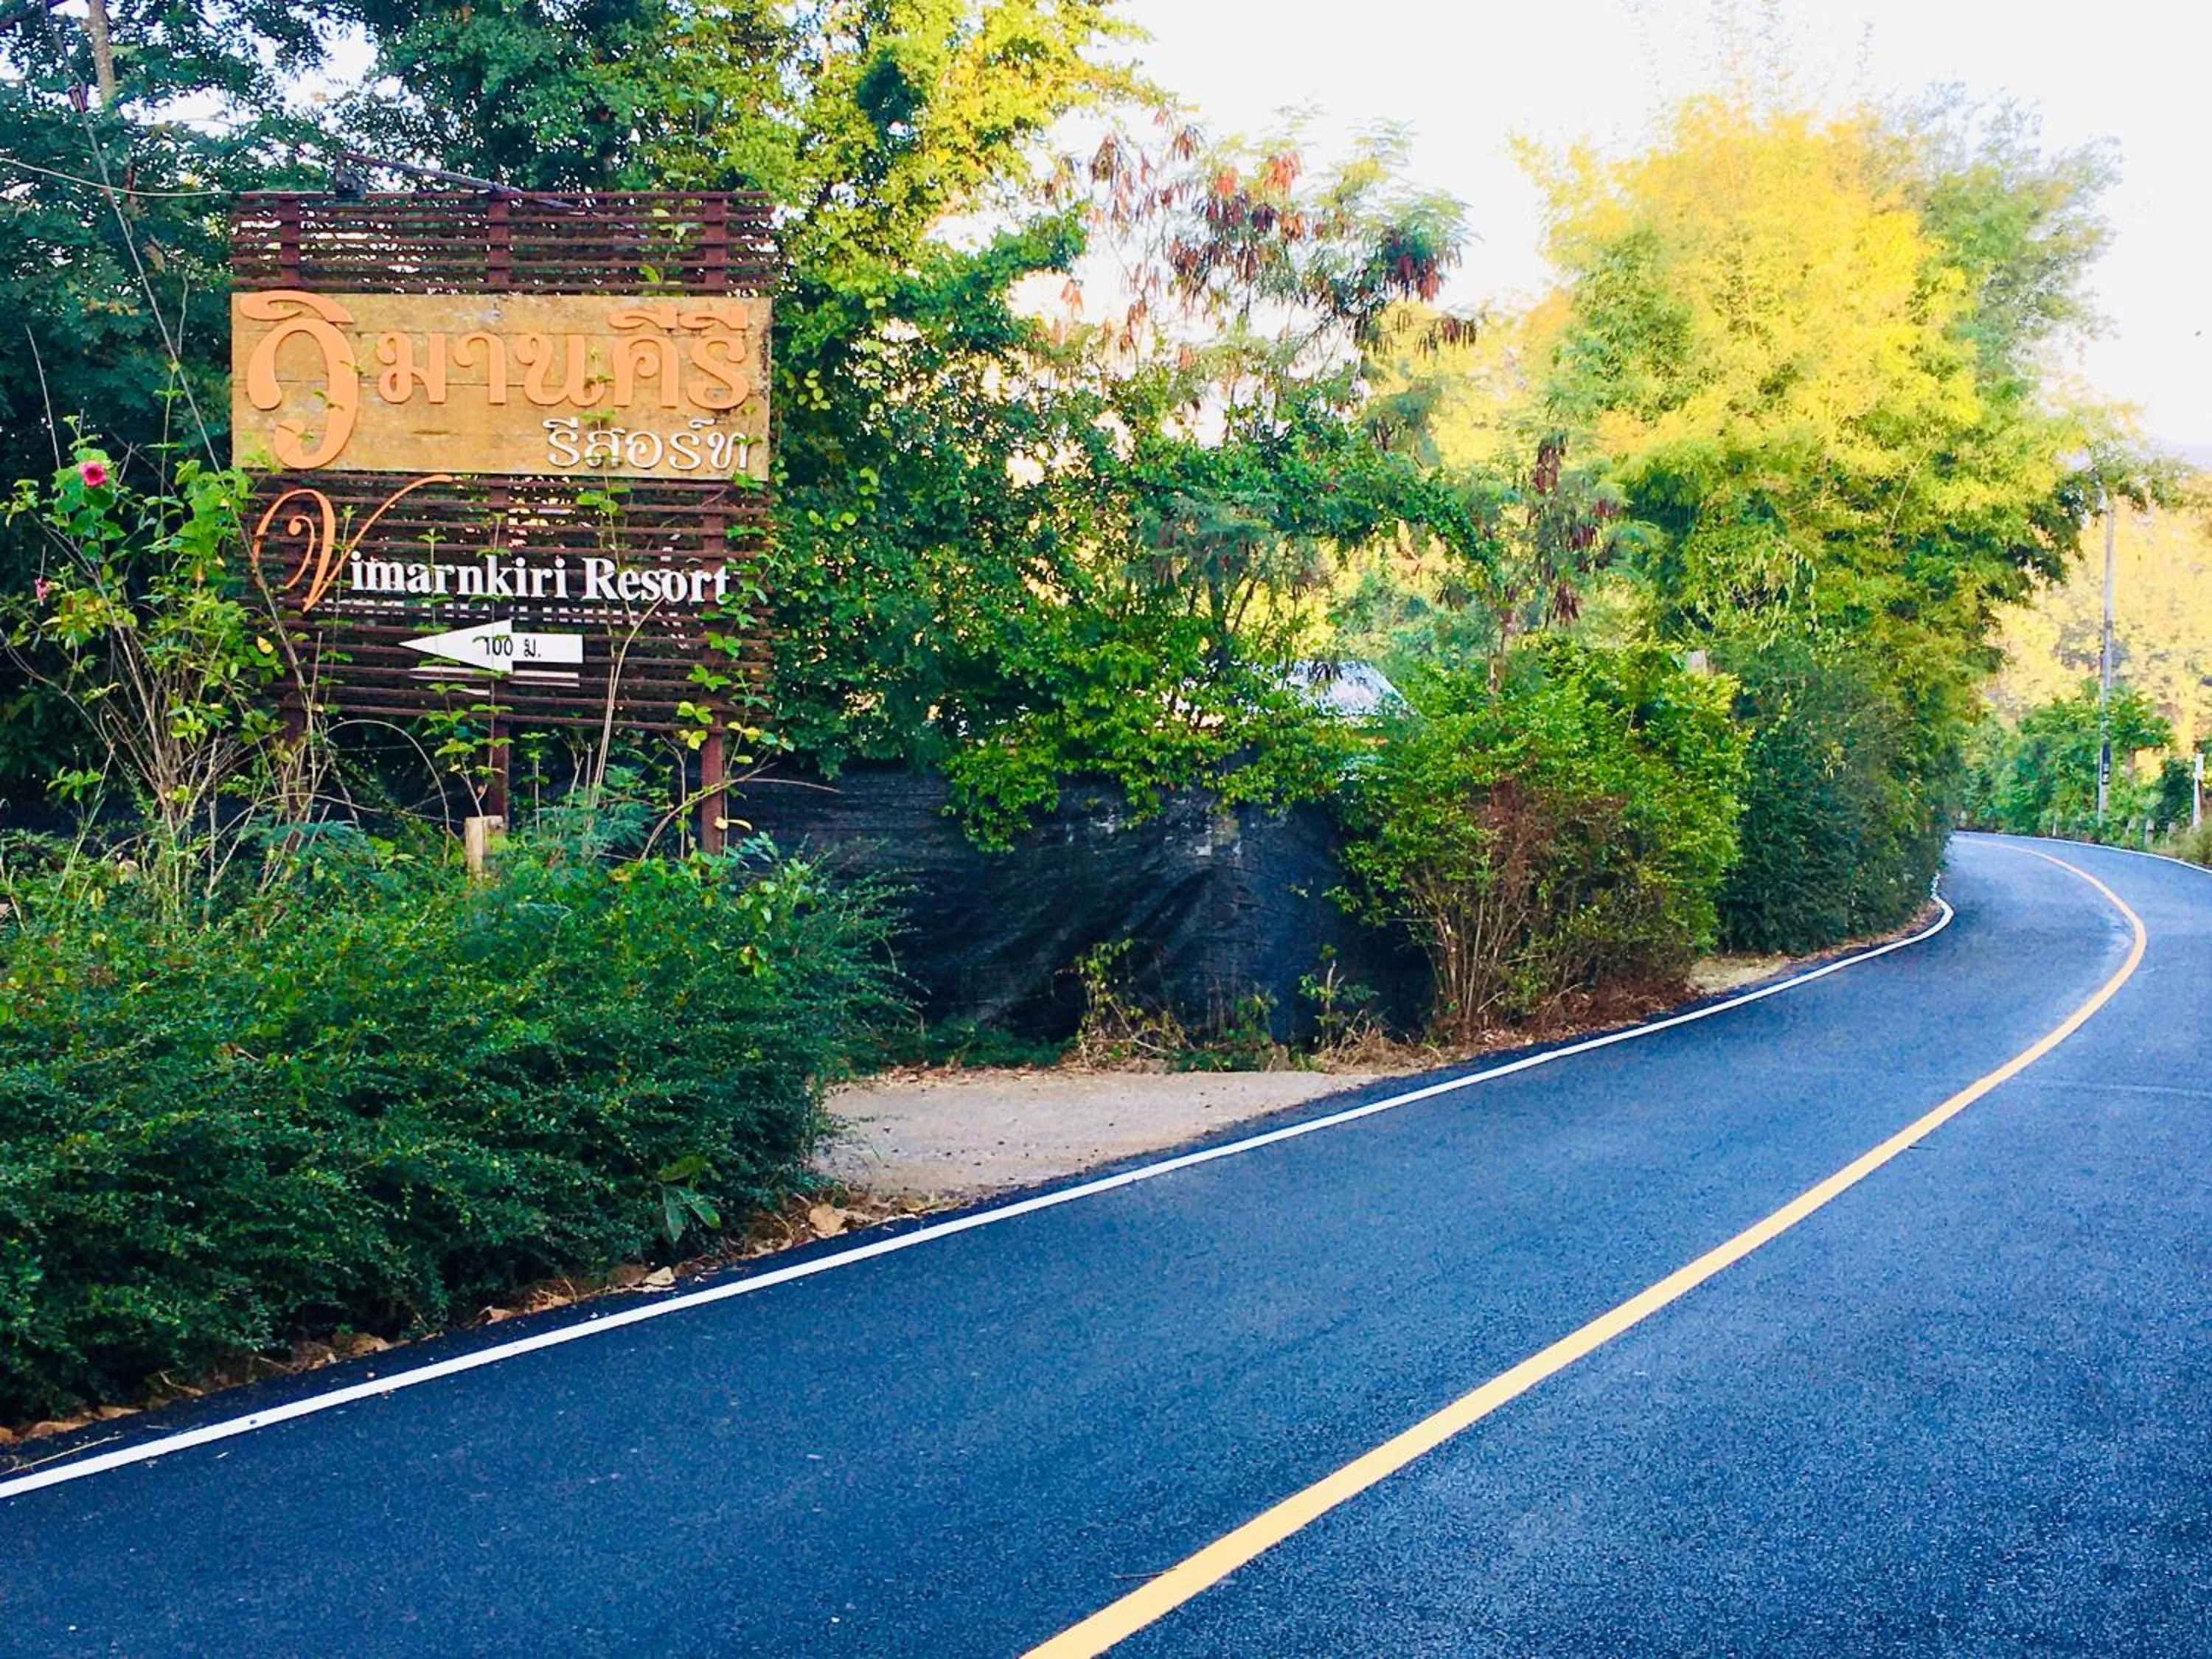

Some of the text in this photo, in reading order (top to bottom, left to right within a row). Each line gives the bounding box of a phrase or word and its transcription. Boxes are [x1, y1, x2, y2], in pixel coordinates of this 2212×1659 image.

[240, 290, 750, 470] วิมานคีรี
[543, 417, 748, 471] รีสอร์ท
[250, 474, 732, 613] Vimarnkiri Resort
[481, 636, 542, 658] 100 ม.
